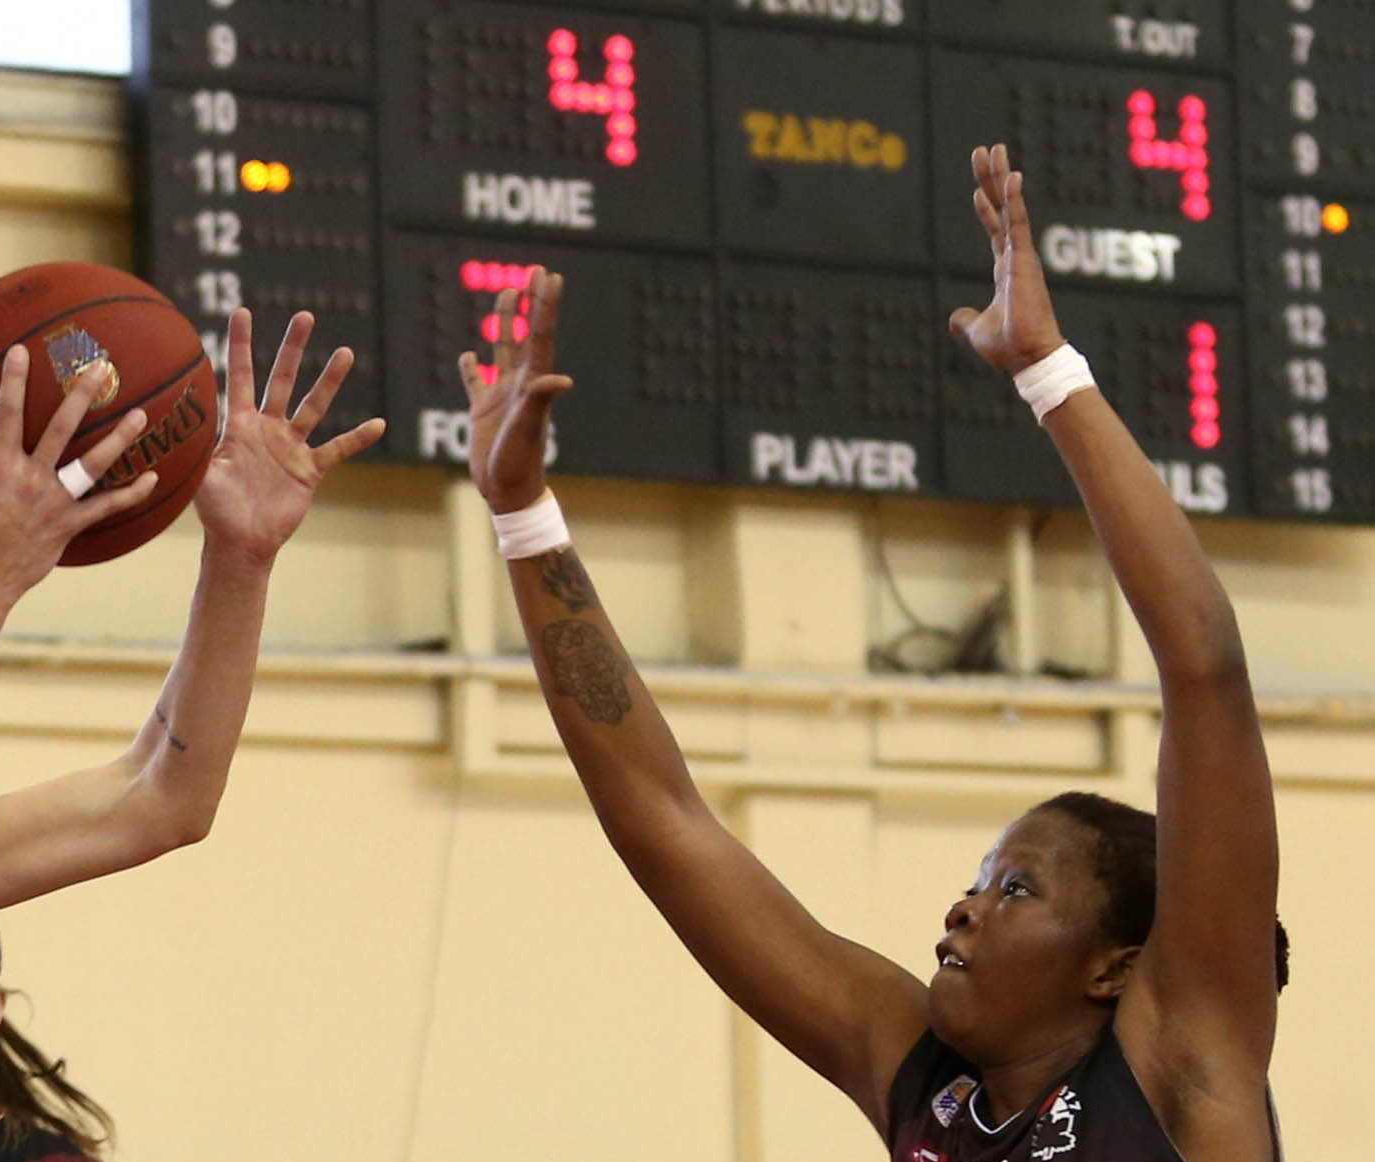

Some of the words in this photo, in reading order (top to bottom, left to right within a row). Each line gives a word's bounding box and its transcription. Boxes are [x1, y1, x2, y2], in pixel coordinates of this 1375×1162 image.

[208, 23, 237, 68] 9
[1291, 23, 1315, 63] 7
[191, 90, 238, 135] 10
[547, 28, 637, 167] 4
[1292, 79, 1318, 121] 8
[192, 149, 237, 194] 11
[1127, 90, 1211, 221] 4
[1293, 133, 1320, 175] 9
[464, 172, 596, 229] HOME
[1281, 196, 1323, 237] 10
[194, 210, 241, 257] 12
[1043, 224, 1183, 283] GUEST
[1282, 249, 1322, 292] 11
[196, 271, 242, 316] 13
[1284, 304, 1326, 348] 12
[1188, 322, 1221, 449] 1
[1287, 359, 1328, 402] 13
[1289, 414, 1331, 456] 14
[752, 432, 919, 490] PLAYER
[1292, 468, 1333, 511] 15
